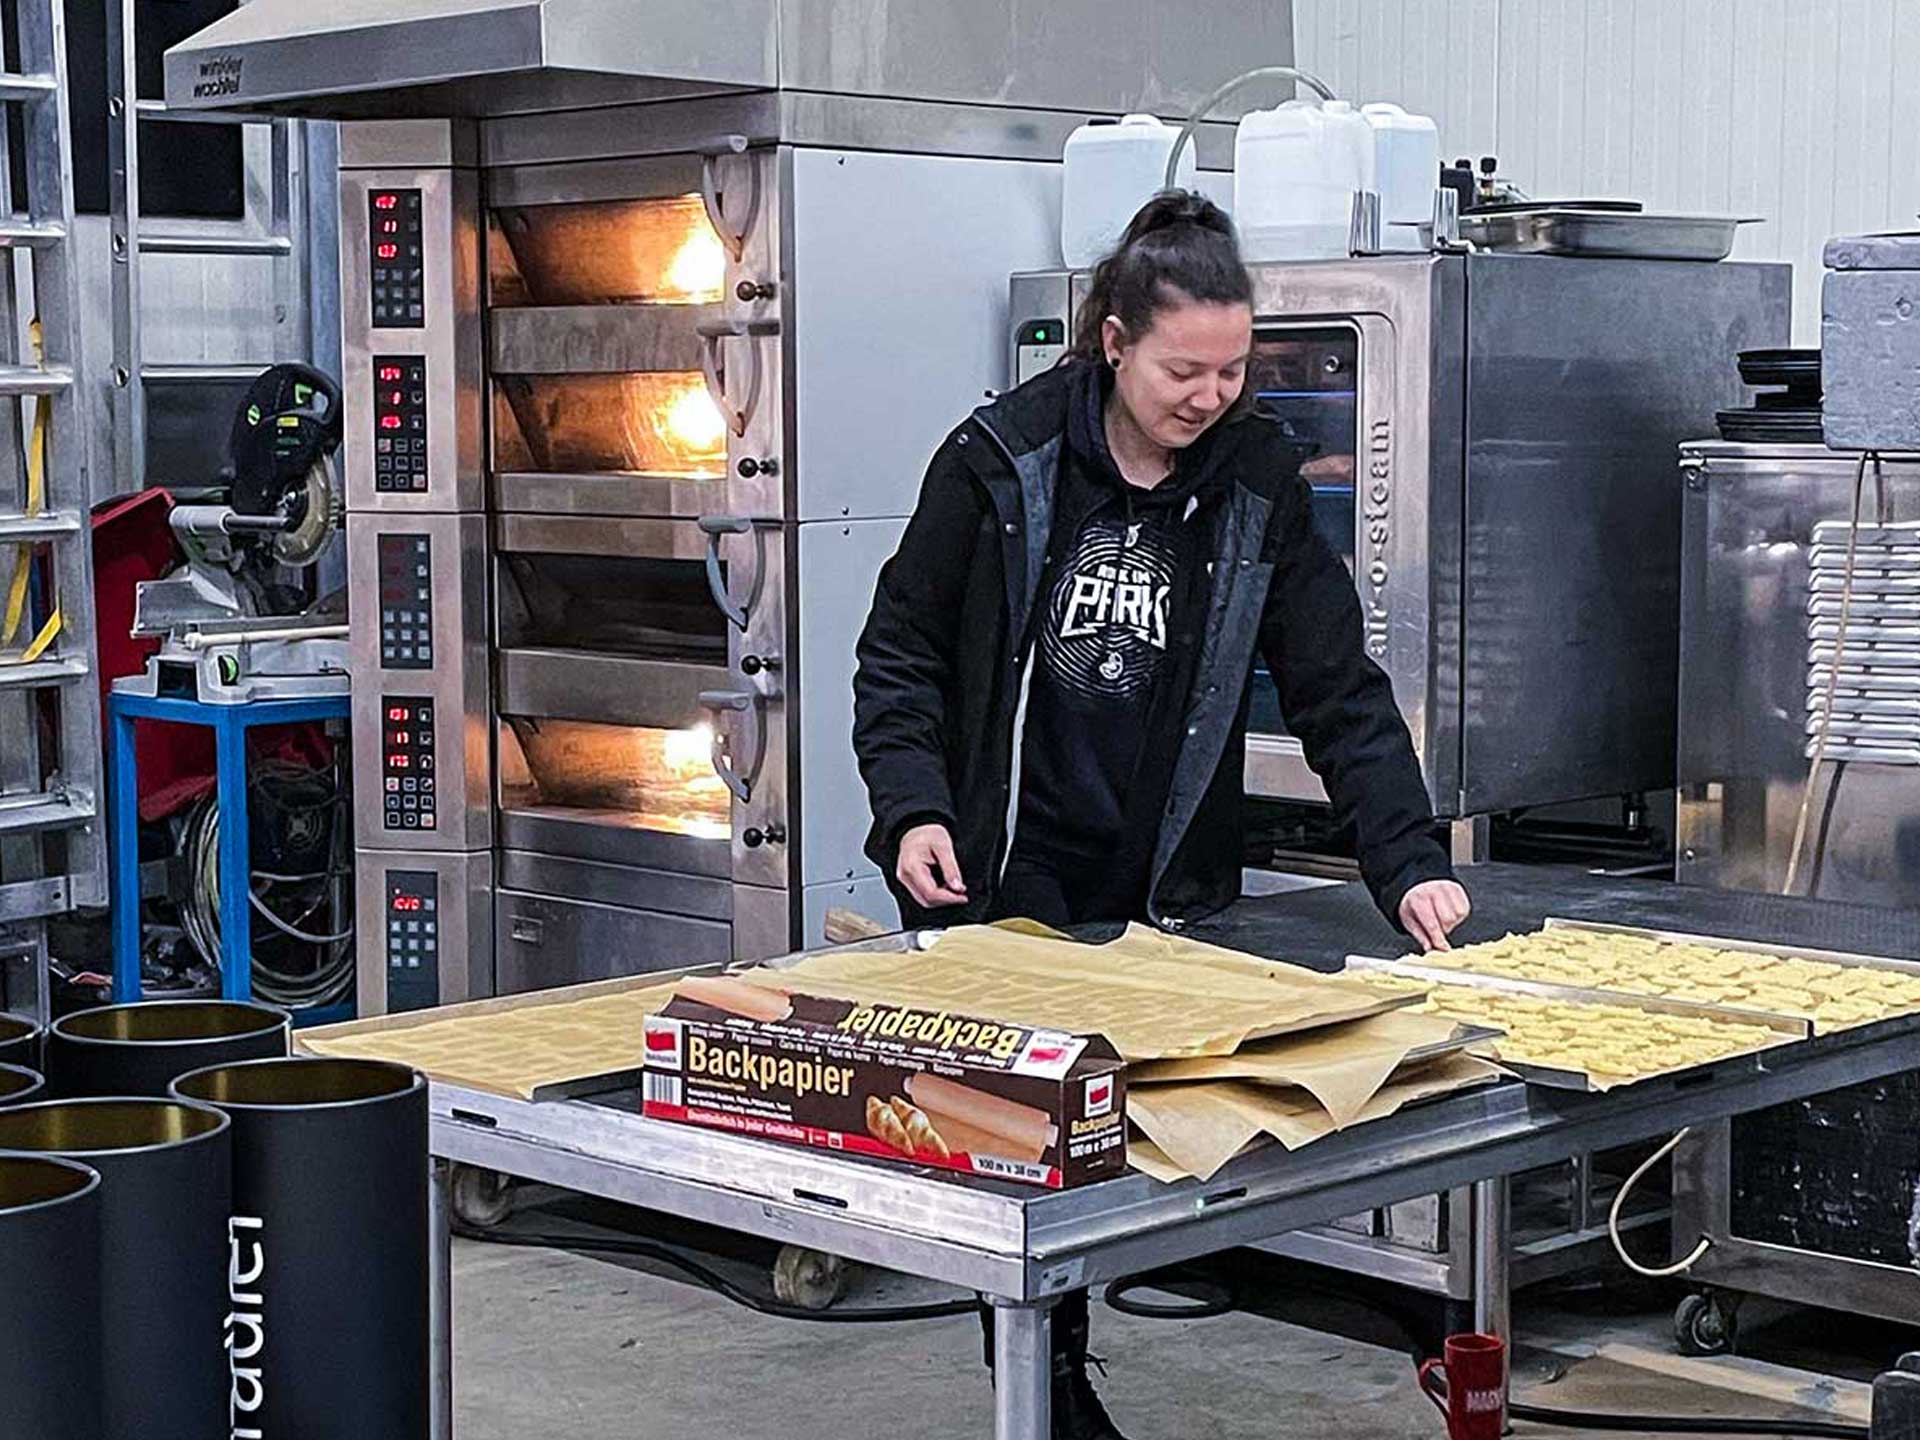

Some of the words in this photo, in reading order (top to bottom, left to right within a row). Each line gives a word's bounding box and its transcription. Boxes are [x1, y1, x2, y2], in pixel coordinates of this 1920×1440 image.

[1096, 564, 1129, 583] ROK
[837, 1007, 1023, 1060] Backpapier
[688, 1035, 855, 1097] Backpapier
